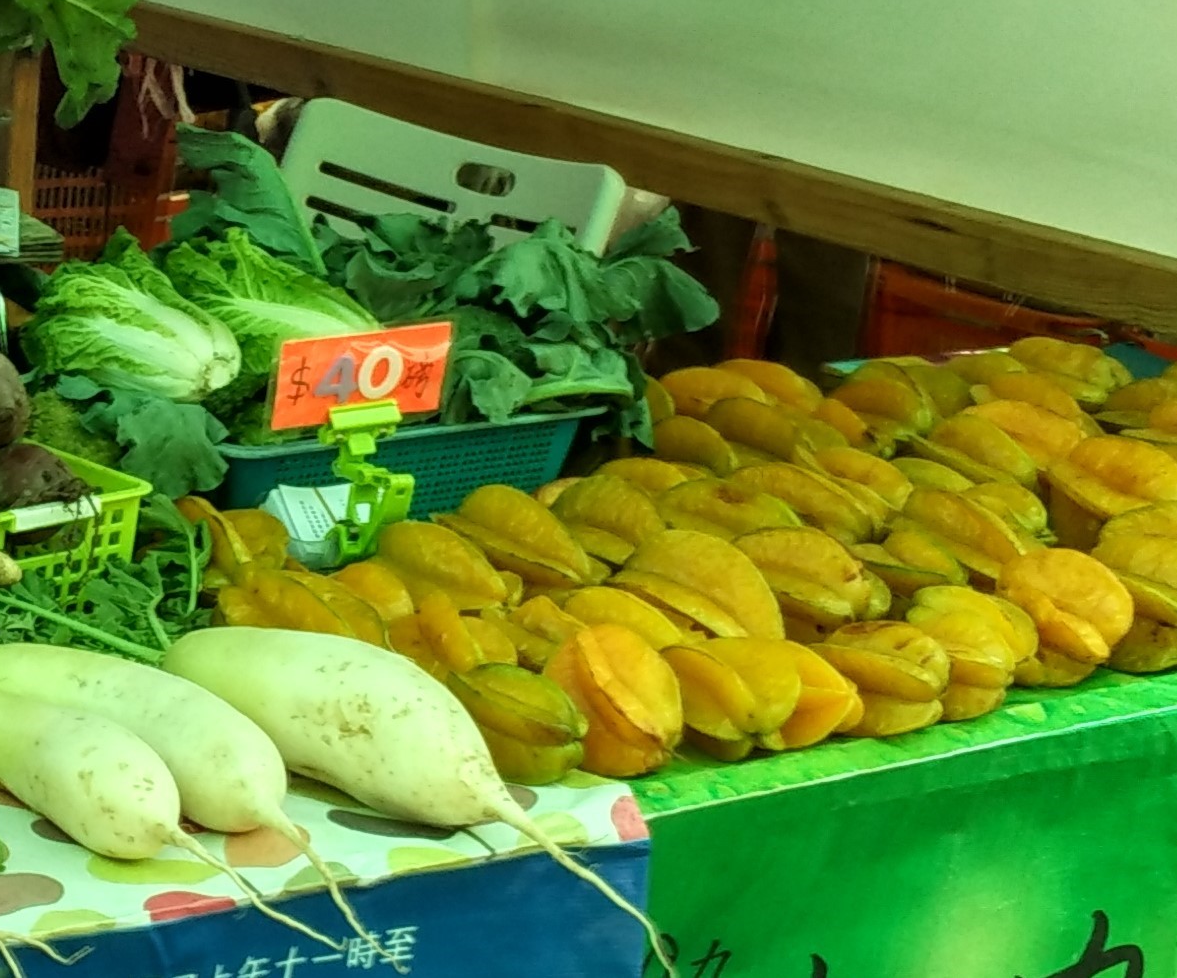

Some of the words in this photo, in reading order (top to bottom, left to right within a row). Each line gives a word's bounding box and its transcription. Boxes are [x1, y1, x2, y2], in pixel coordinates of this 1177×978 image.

[172, 925, 419, 978] 午十一時至
